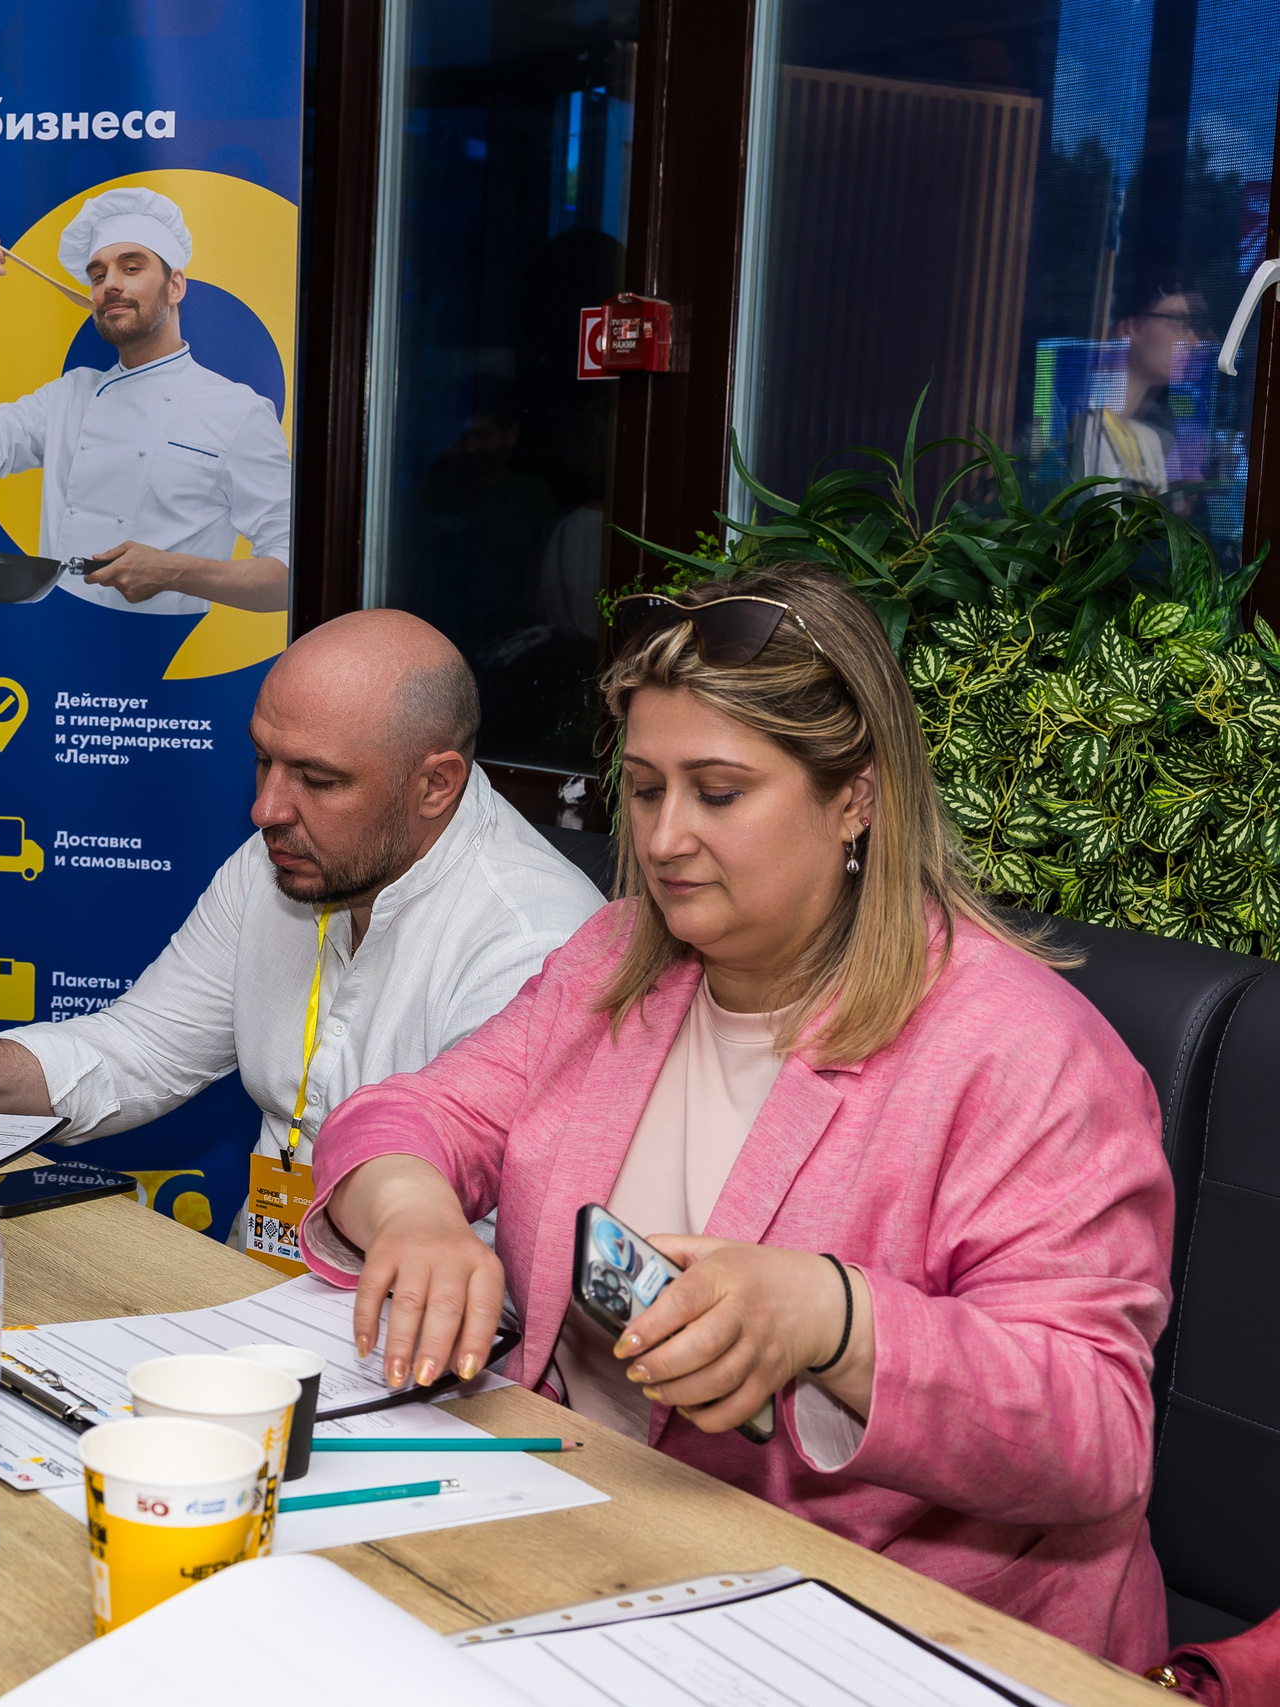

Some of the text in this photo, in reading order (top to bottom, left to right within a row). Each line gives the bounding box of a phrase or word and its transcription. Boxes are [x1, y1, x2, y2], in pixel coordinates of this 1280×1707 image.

[55, 691, 148, 712] Действует
[55, 715, 212, 733] в гипермаркетах
[55, 733, 214, 751] и супермаркетах
[55, 749, 130, 765] «Лента»
[54, 831, 142, 849] Доставка
[54, 855, 172, 871] и самовывоз
[52, 971, 120, 989] Пакеты
